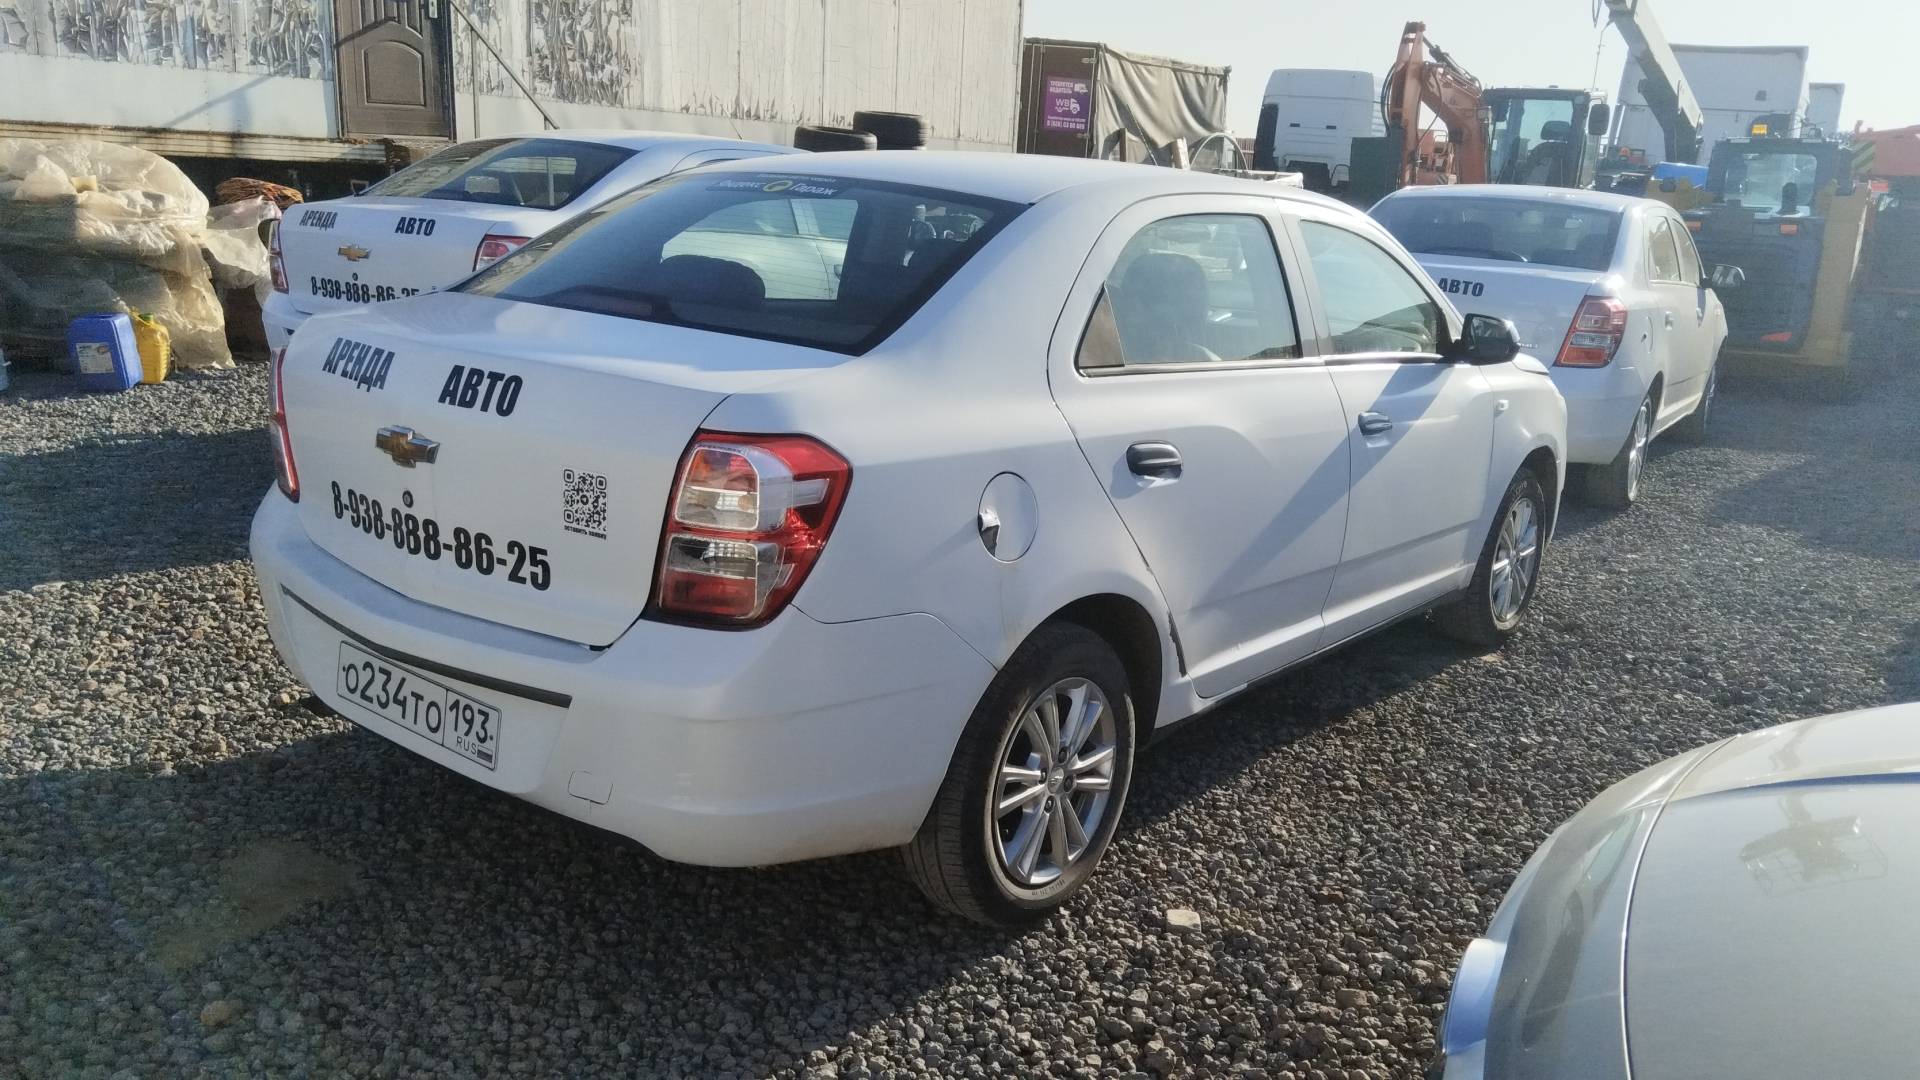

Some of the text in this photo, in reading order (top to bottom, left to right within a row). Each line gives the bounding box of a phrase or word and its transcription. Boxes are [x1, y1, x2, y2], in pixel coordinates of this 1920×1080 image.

[1055, 98, 1070, 107] WB
[300, 209, 436, 236] АРЕНДА АВТО
[1437, 277, 1485, 297] АВТО
[321, 336, 524, 417] АРЕНДА АВТО
[331, 480, 551, 591] 8-938-888-86-25
[449, 699, 490, 744] 193
[456, 736, 477, 756] RUS
